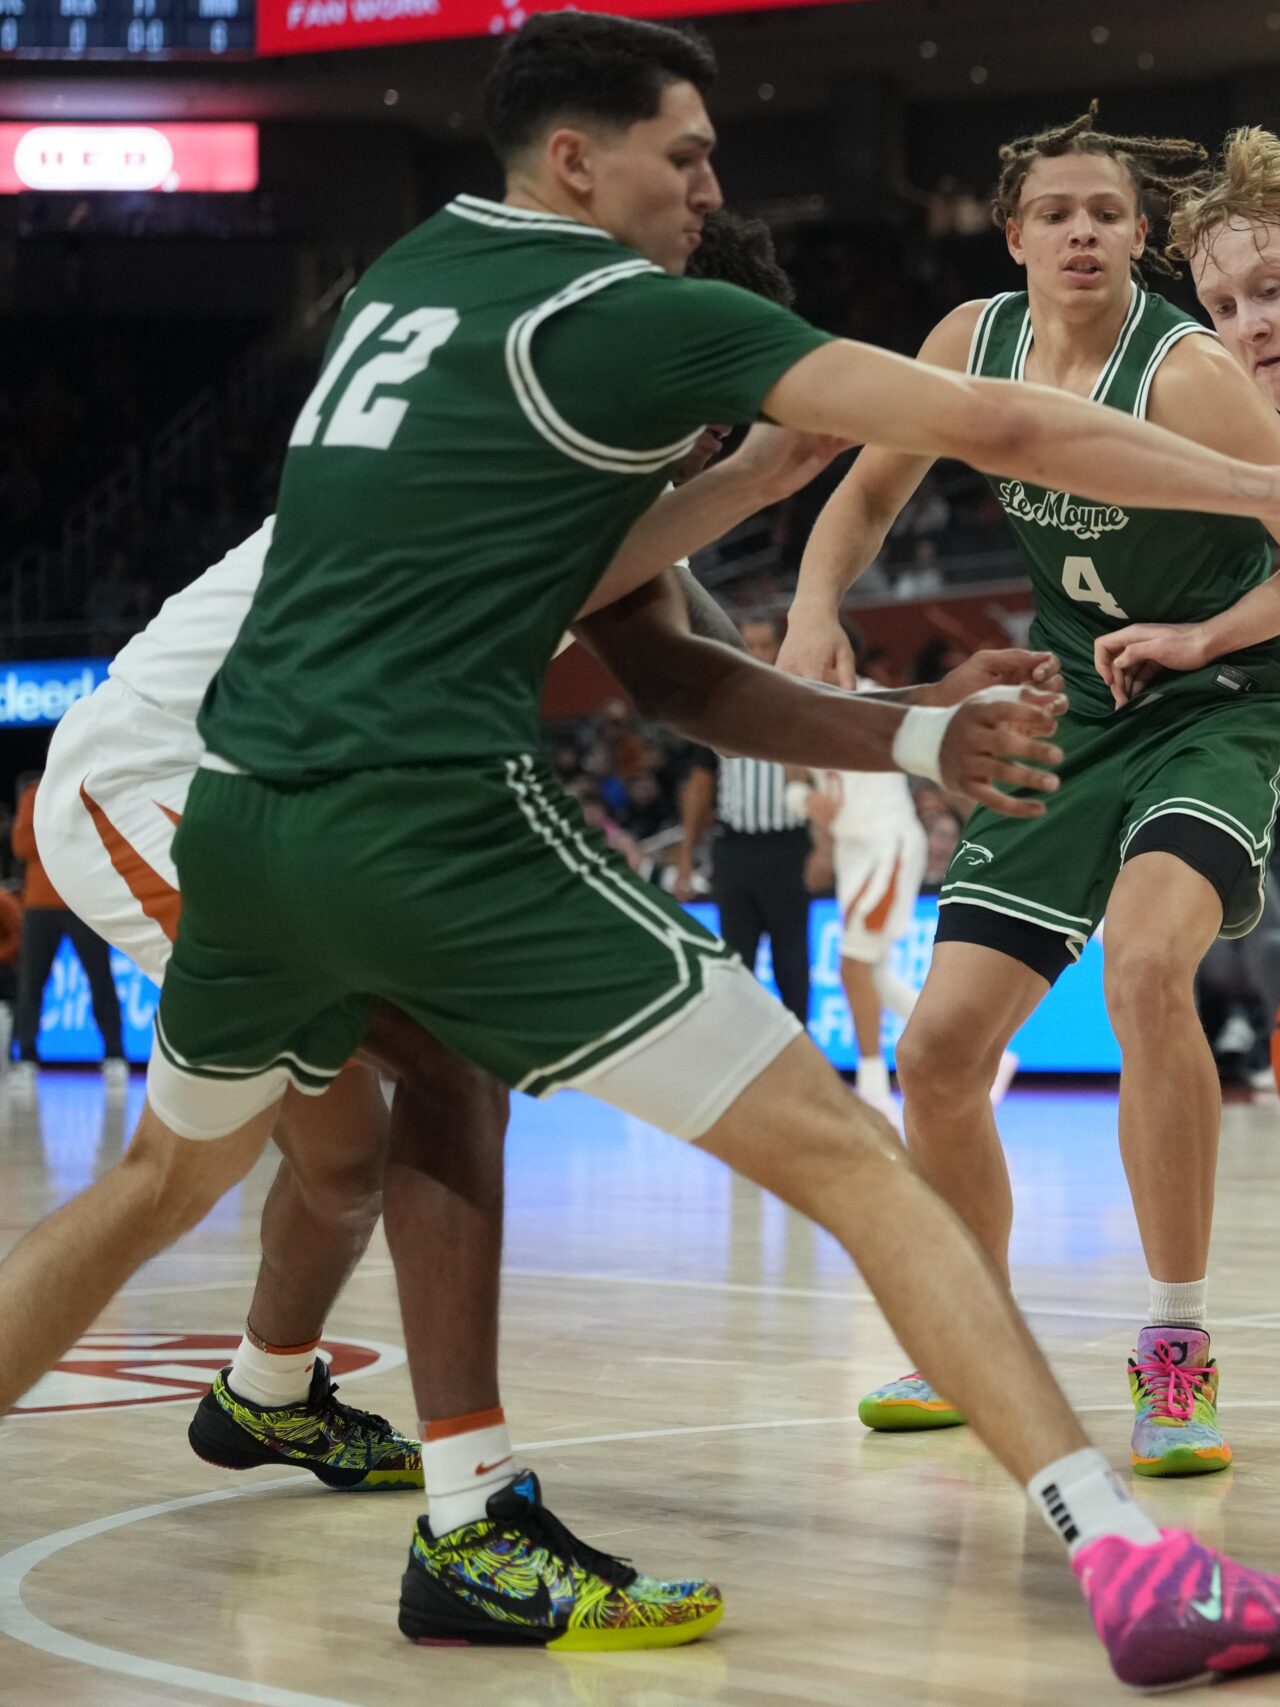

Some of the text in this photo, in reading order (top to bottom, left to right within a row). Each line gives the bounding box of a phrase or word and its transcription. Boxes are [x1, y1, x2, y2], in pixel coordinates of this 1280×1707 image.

[287, 301, 461, 451] 12
[999, 479, 1131, 541] Le Moyne
[1061, 555, 1131, 620] 4
[0, 666, 95, 722] deed
